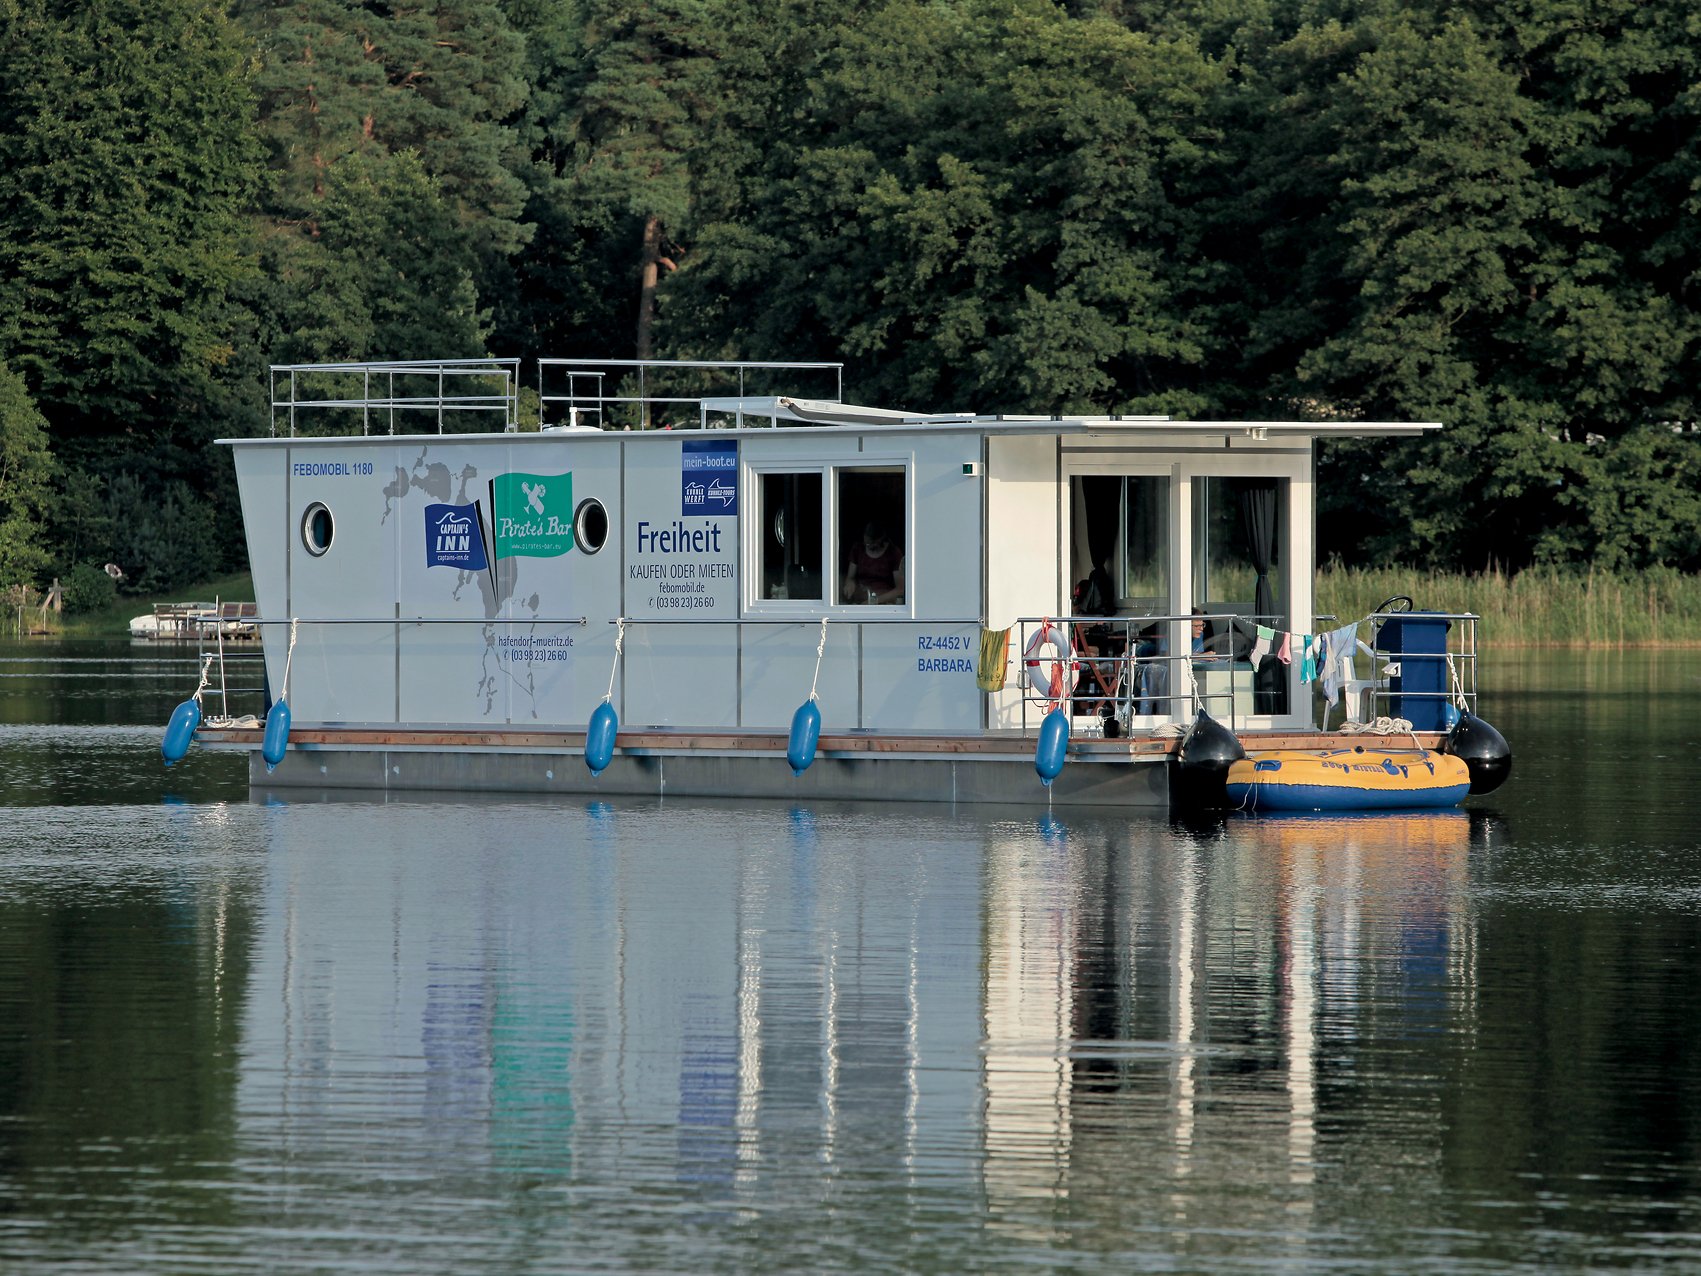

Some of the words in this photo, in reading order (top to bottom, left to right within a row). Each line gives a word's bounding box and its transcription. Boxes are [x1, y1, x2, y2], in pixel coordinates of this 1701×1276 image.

[683, 455, 736, 468] mein-boot.eu
[293, 463, 350, 476] FEBOMOBIL
[353, 462, 373, 475] 1180
[684, 495, 705, 503] WERFT
[499, 517, 544, 538] Pirate's
[545, 515, 572, 536] Bar
[436, 535, 470, 551] INN
[638, 520, 721, 553] Freiheit
[630, 564, 667, 579] KAUFEN
[670, 564, 696, 578] ODER
[698, 563, 734, 578] MIETEN
[659, 581, 705, 593] febomobil.de
[498, 635, 574, 647] hafendorf-mueritz.de
[918, 636, 960, 650] RZ-4452
[963, 636, 971, 650] V
[918, 658, 973, 672] BARBARA
